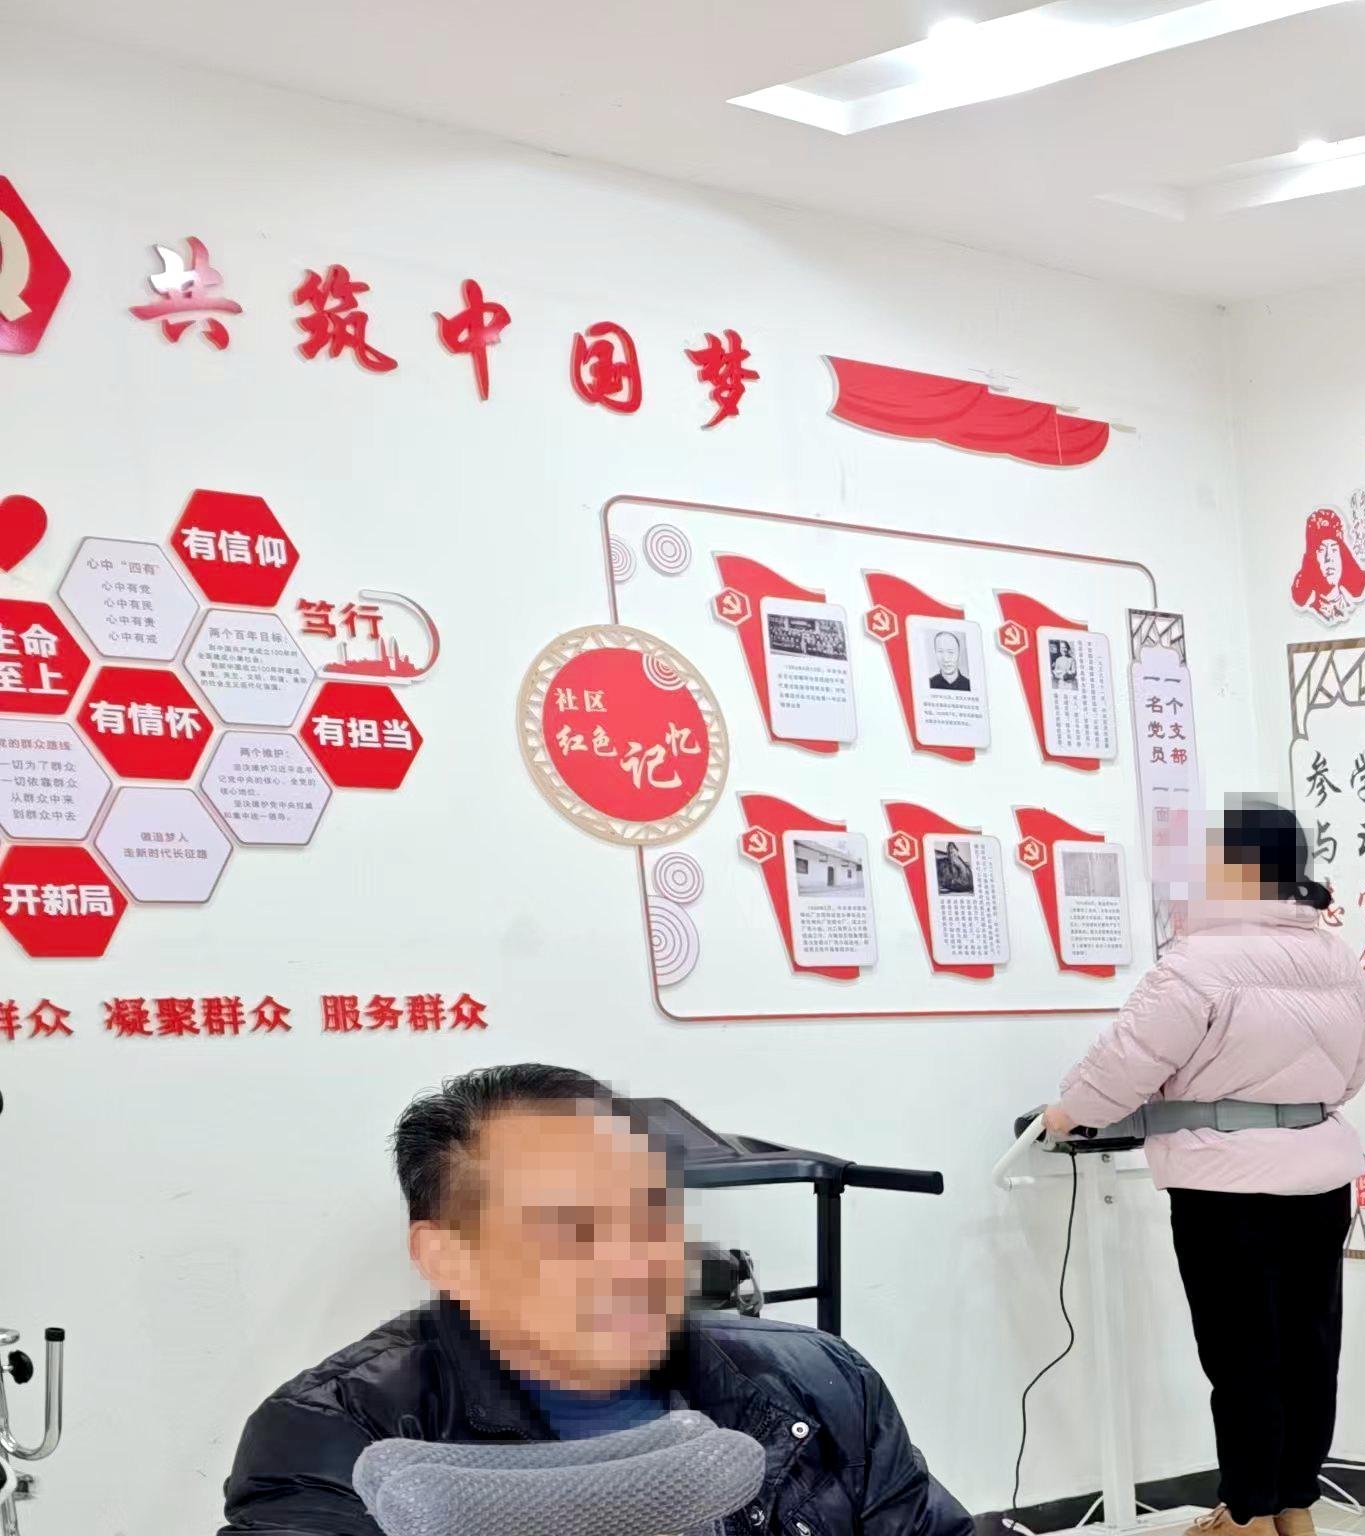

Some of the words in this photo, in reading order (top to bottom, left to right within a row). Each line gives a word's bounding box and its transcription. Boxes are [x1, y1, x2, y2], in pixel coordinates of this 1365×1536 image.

[128, 235, 762, 431] 共筑中国梦
[181, 526, 289, 569] 有信仰
[295, 598, 384, 641] 笃行
[88, 700, 202, 740] 有情怀
[554, 687, 608, 713] 社区
[312, 713, 413, 752] 有担当
[2, 883, 115, 917] 开新局
[102, 995, 293, 1039] 凝聚群众
[320, 992, 489, 1034] 服务群众
